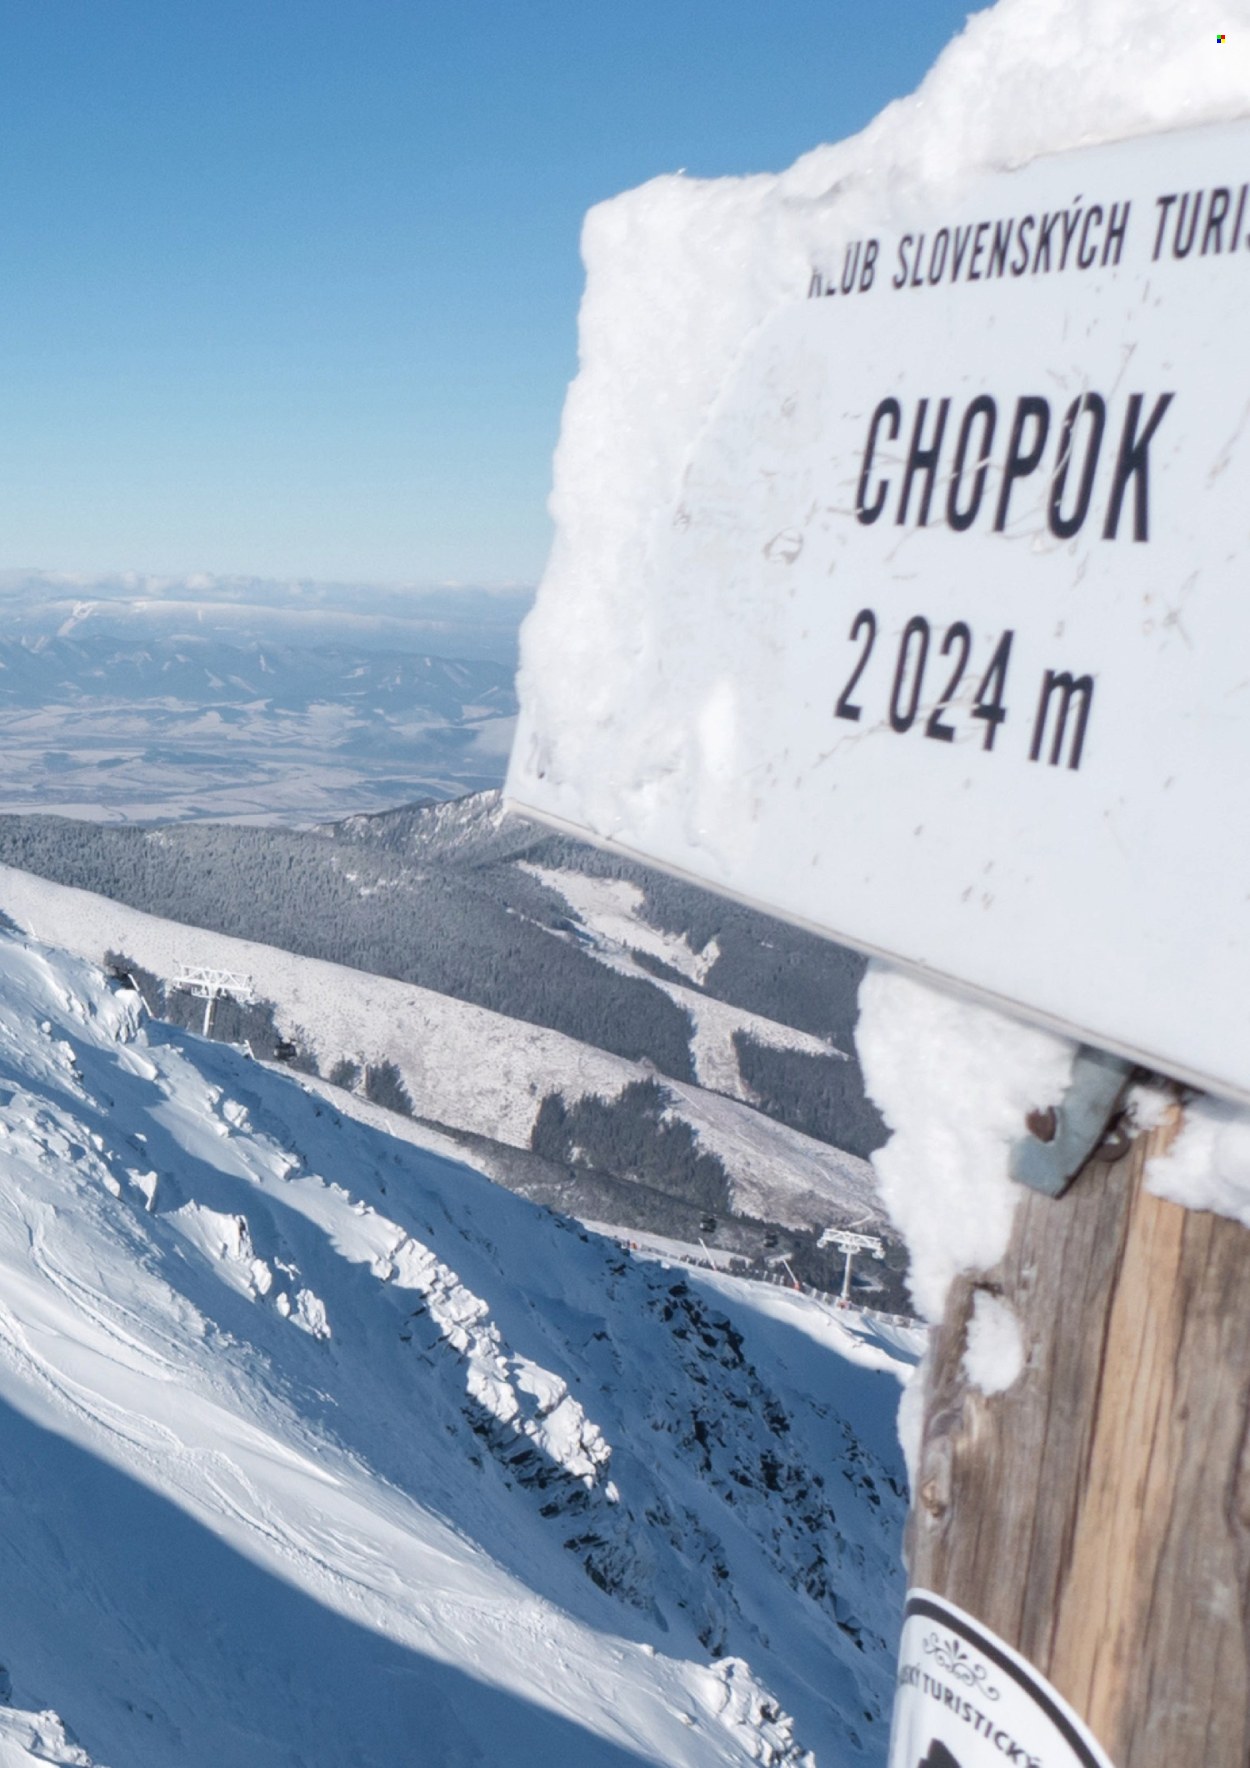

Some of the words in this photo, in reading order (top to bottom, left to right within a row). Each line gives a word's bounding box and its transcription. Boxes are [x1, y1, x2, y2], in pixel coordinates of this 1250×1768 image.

[892, 195, 1131, 290] SLOVENSKÝCH
[1152, 183, 1250, 262] TURI
[855, 392, 1176, 542] CHOPOK
[1028, 669, 1094, 770] m
